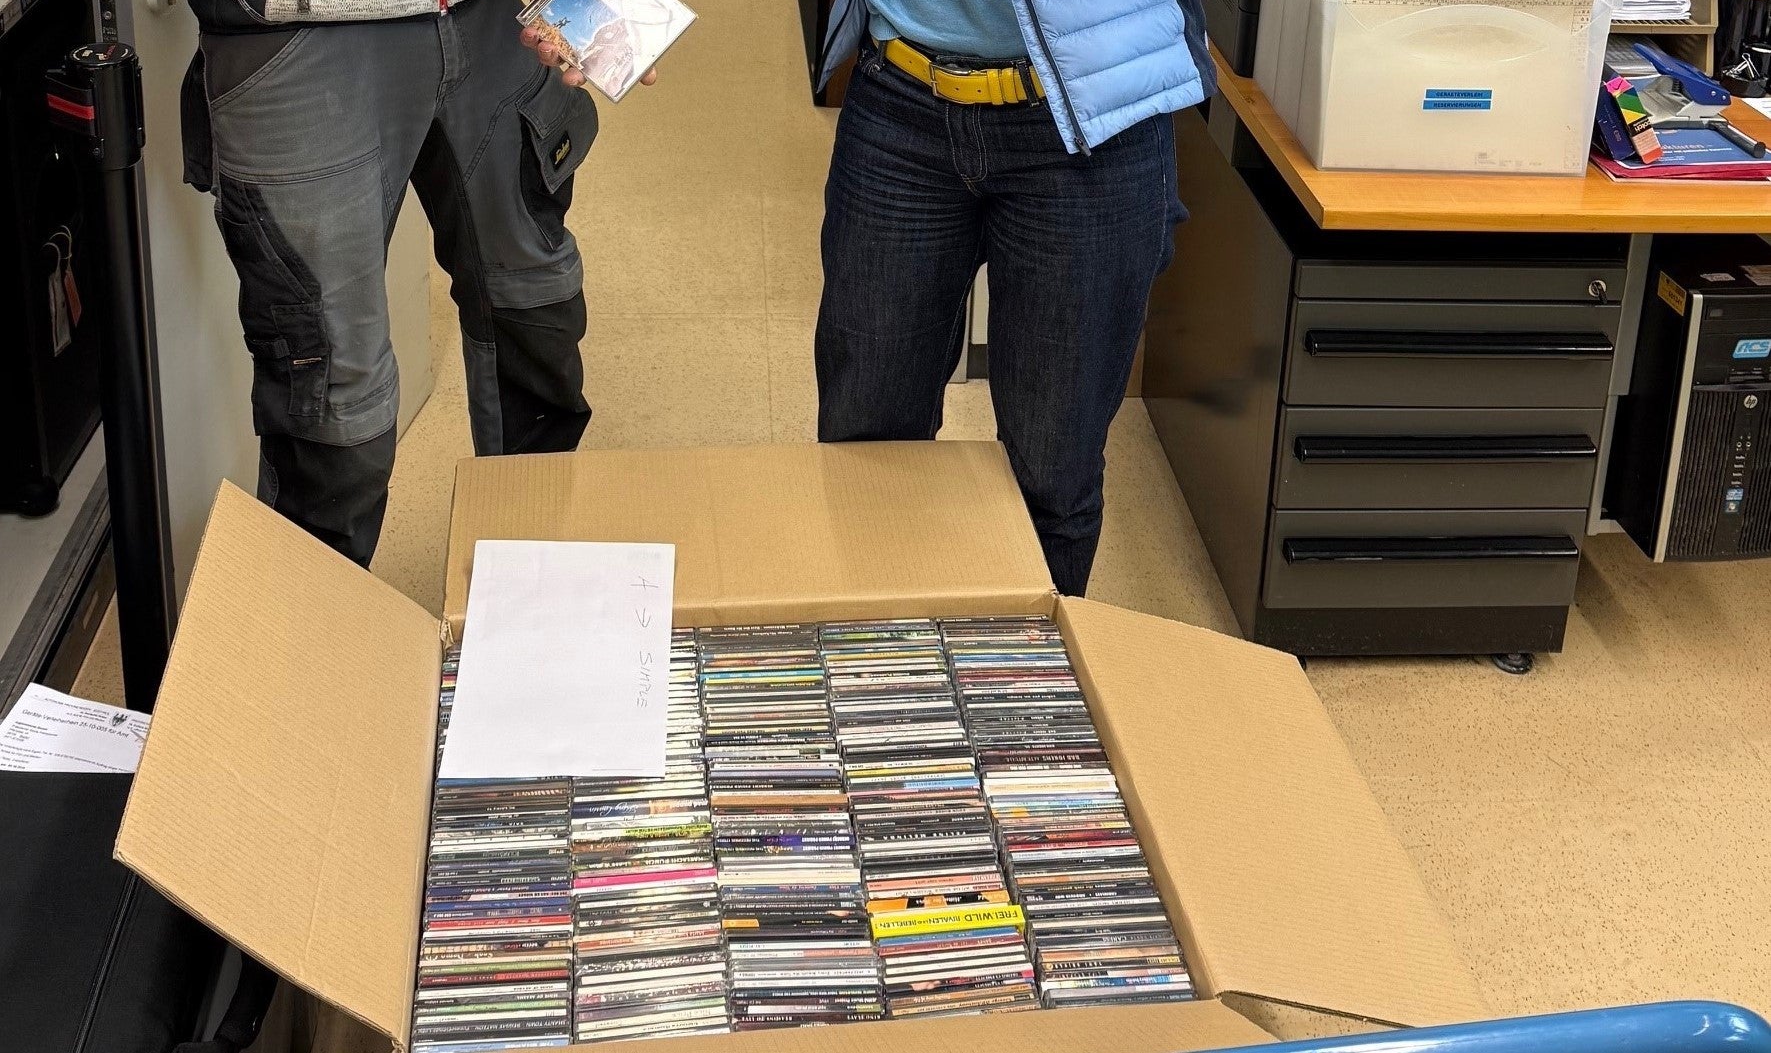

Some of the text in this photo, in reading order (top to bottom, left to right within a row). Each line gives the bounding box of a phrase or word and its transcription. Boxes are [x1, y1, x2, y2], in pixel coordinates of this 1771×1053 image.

[117, 728, 130, 739] Amt
[929, 915, 960, 924] RIVALEN
[965, 910, 1017, 922] FREI.WILD
[880, 919, 916, 928] REBELLEN
